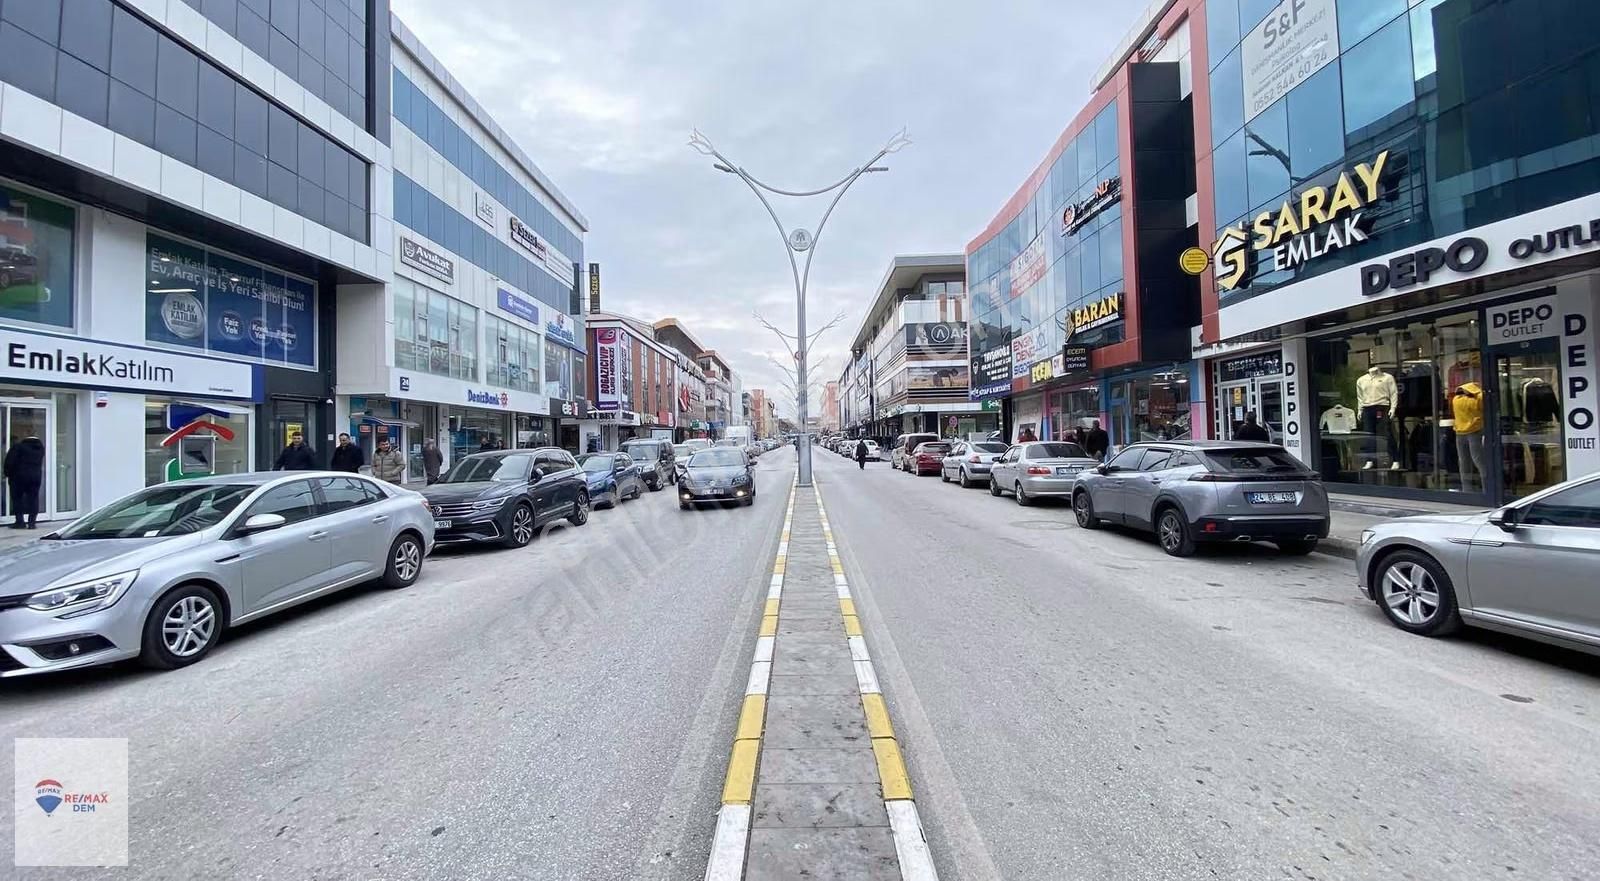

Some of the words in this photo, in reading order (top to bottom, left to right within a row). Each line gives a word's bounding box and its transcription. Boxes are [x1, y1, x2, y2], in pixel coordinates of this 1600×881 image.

[1254, 150, 1388, 250] SARAY
[1274, 213, 1366, 272] EMLAK
[151, 260, 171, 278] Ev,
[172, 265, 200, 286] Araç
[203, 276, 215, 288] ve
[229, 281, 250, 297] Yeri
[1361, 237, 1489, 296] DEPO
[170, 310, 198, 323] KATILIM
[172, 301, 196, 313] EMLAK
[1074, 292, 1119, 328] BARAN
[1492, 304, 1553, 329] DEPO
[224, 317, 240, 327] Faiz
[225, 325, 239, 335] Yok
[1502, 323, 1544, 338] OUTLET
[8, 342, 174, 383] EmlakKatılım
[1564, 313, 1594, 430] DEPO
[468, 389, 500, 406] DenizBank
[1567, 437, 1596, 449] OUTLET
